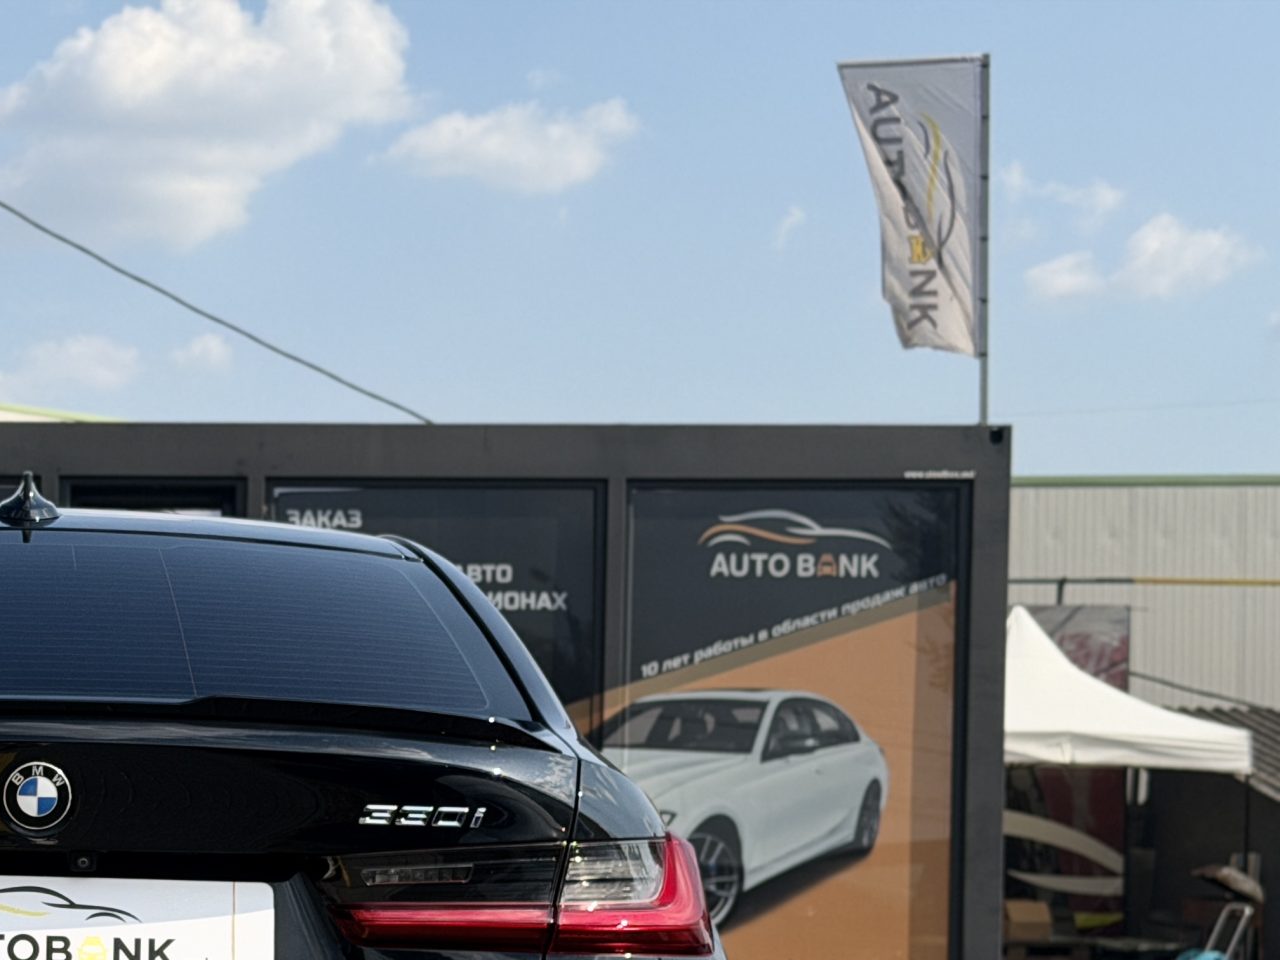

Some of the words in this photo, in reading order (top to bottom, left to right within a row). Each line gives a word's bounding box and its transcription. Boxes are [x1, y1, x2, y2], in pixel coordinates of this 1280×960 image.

[709, 552, 791, 578] AUTO
[641, 660, 659, 678] 10
[662, 652, 690, 672] лет
[693, 633, 755, 665] работы
[757, 628, 769, 643] в
[771, 606, 838, 638] области
[841, 585, 907, 616] продаж
[11, 765, 65, 787] BMW
[358, 804, 487, 829] 330i
